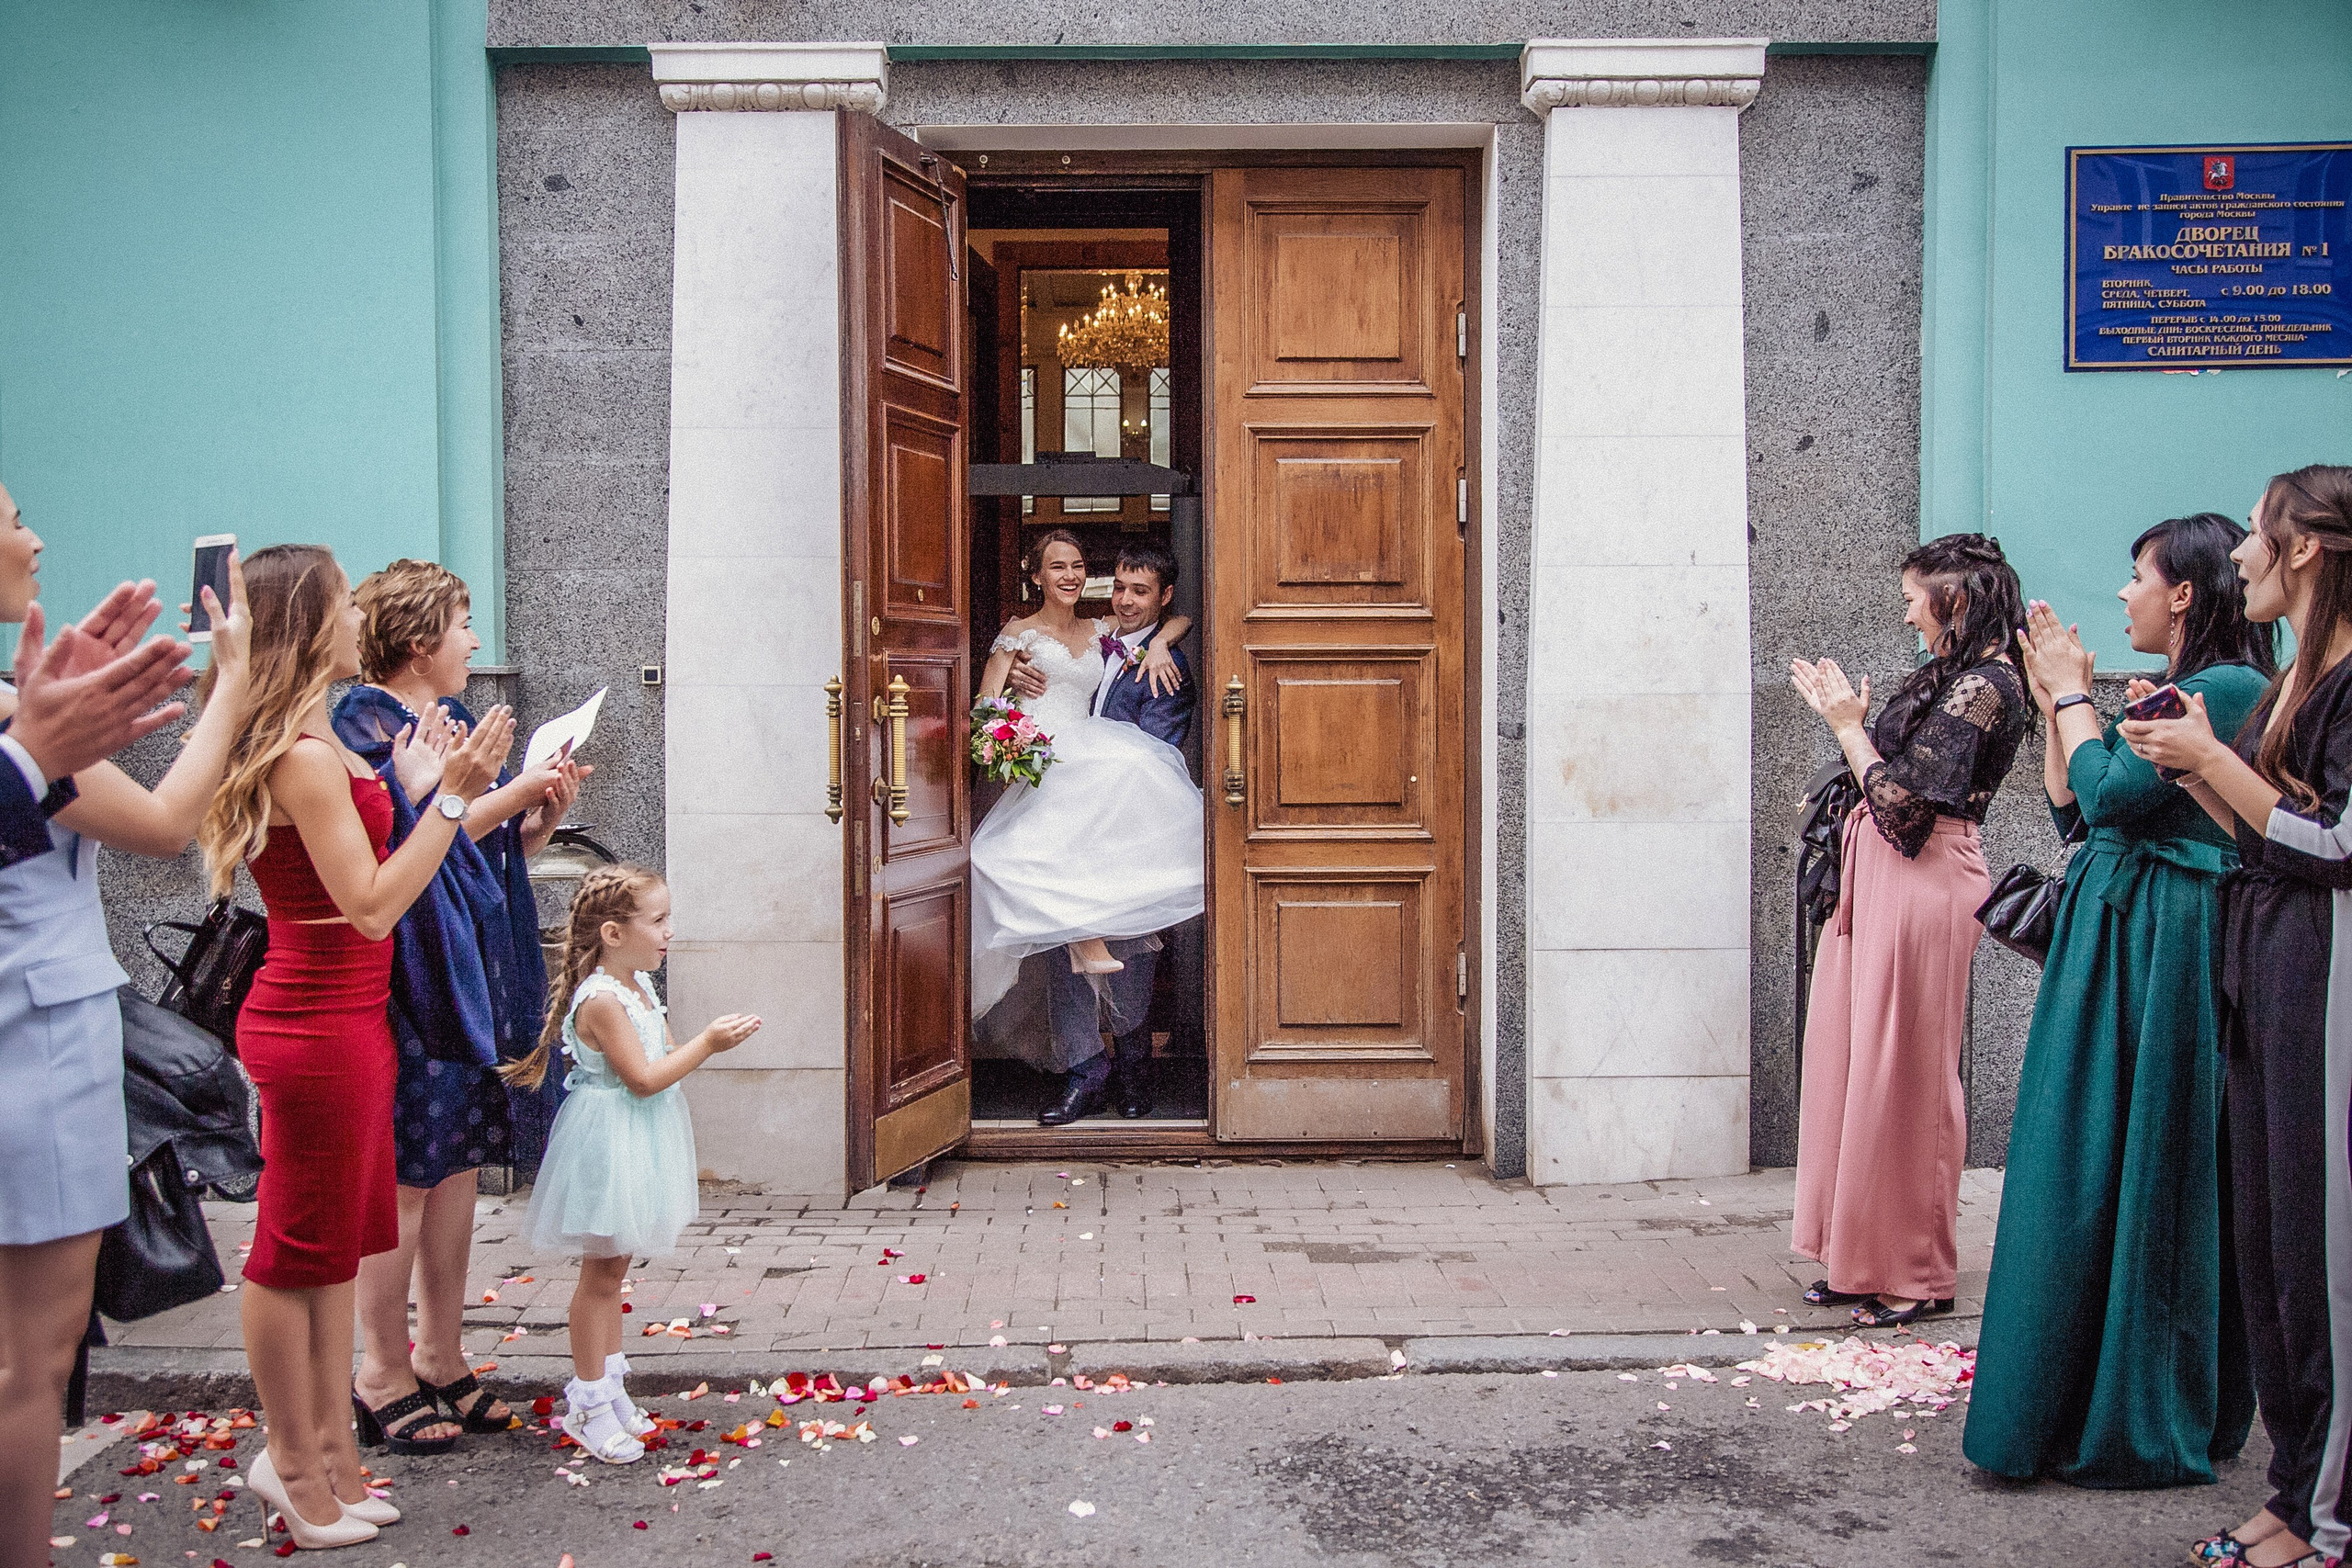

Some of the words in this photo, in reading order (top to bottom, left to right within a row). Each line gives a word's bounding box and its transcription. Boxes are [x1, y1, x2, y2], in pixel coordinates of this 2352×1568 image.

[2160, 194, 2233, 202] Правительство
[2236, 192, 2276, 200] Москвы
[2153, 201, 2187, 210] записи
[2189, 201, 2218, 209] актов
[2221, 200, 2290, 209] гражданского
[2179, 211, 2213, 220] города
[2175, 226, 2259, 244] ДВОРЕЦ
[2103, 243, 2290, 260] БРАКОСОЧЕТАНИЯ
[2322, 242, 2328, 256] 1
[2171, 265, 2208, 274] ЧАСЫ
[2211, 264, 2263, 274] РАБОТЫ
[2232, 285, 2265, 296] 9.00
[2267, 286, 2287, 297] до
[2291, 284, 2332, 295] 18.00
[2158, 299, 2206, 308] СУББОТА
[2098, 326, 2156, 334] ВЫХОДНЫЕ
[2157, 326, 2183, 334] ДНИ:
[2260, 323, 2332, 332] ПОНЕДЕЛЬНИК
[2122, 335, 2164, 344] ПЕРВЫЙ
[2166, 335, 2211, 344] ВТОРНИК
[2147, 344, 2242, 355] САНИТАРНЫЙ
[2245, 344, 2282, 356] ДЕНЬ
